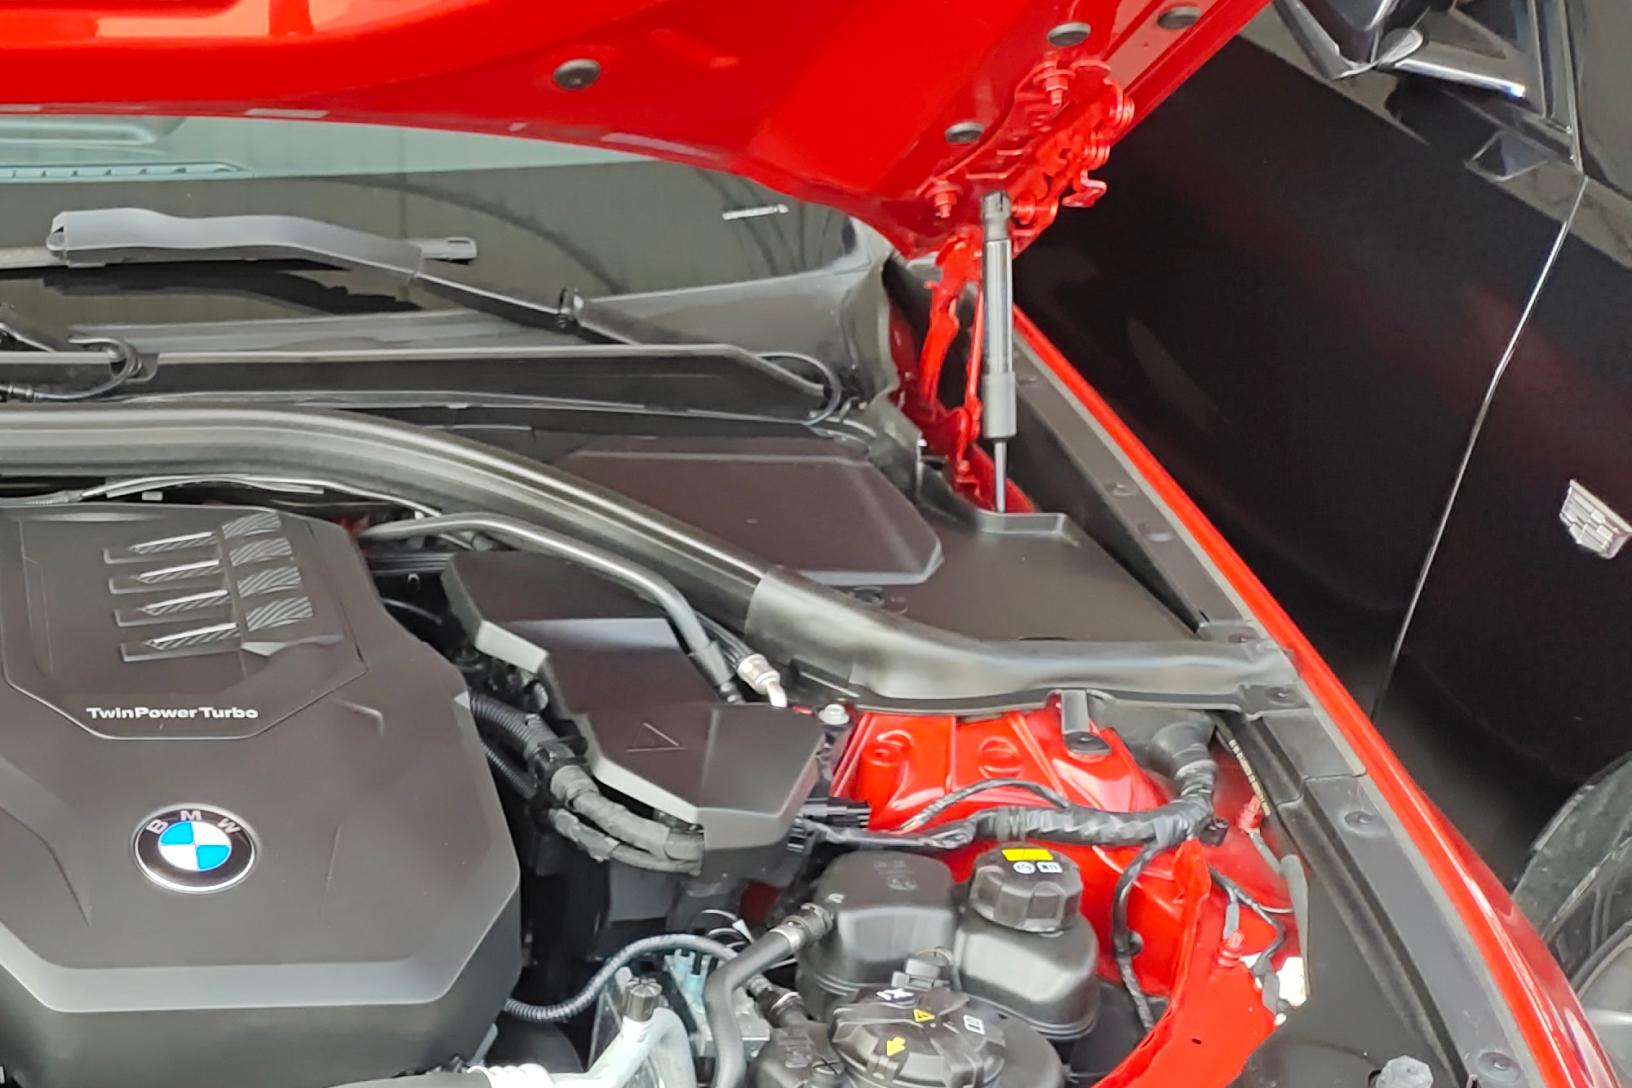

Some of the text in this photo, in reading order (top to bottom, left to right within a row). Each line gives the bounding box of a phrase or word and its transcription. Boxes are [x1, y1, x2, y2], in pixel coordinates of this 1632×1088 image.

[86, 707, 258, 719] TwinPower Turbo
[146, 810, 241, 834] BMW
